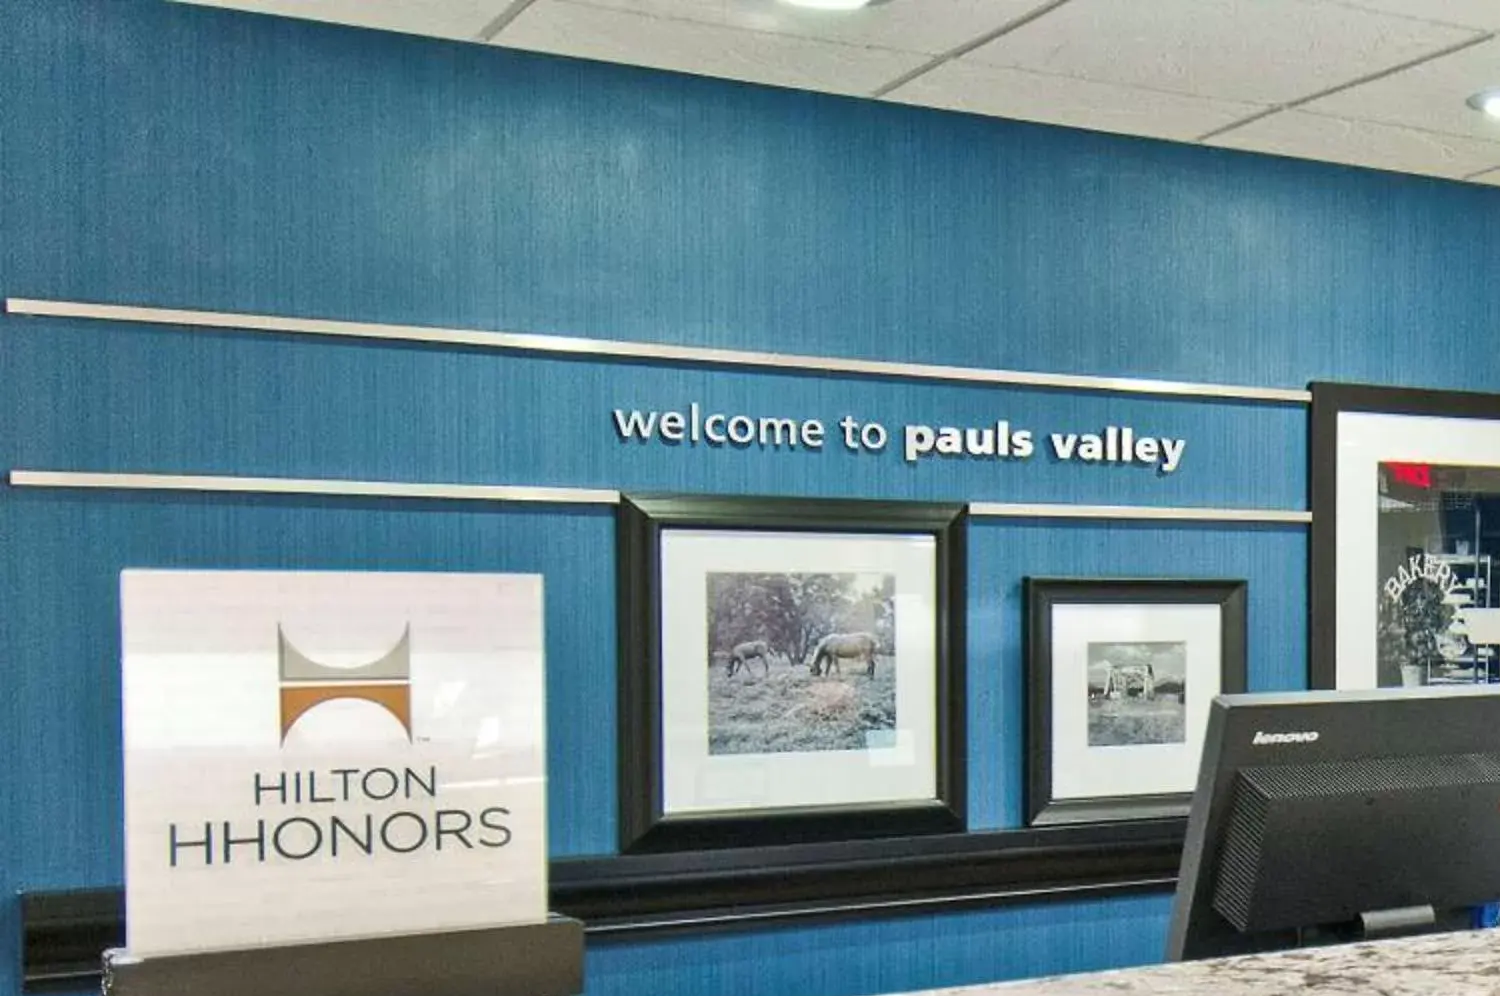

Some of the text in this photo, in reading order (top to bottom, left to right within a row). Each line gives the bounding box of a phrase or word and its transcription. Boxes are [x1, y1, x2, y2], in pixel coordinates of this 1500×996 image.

[612, 402, 1187, 472] welcome to pauls valley
[1252, 730, 1320, 746] lenovo
[254, 765, 436, 806] HILTON
[169, 807, 512, 868] HHONORS
